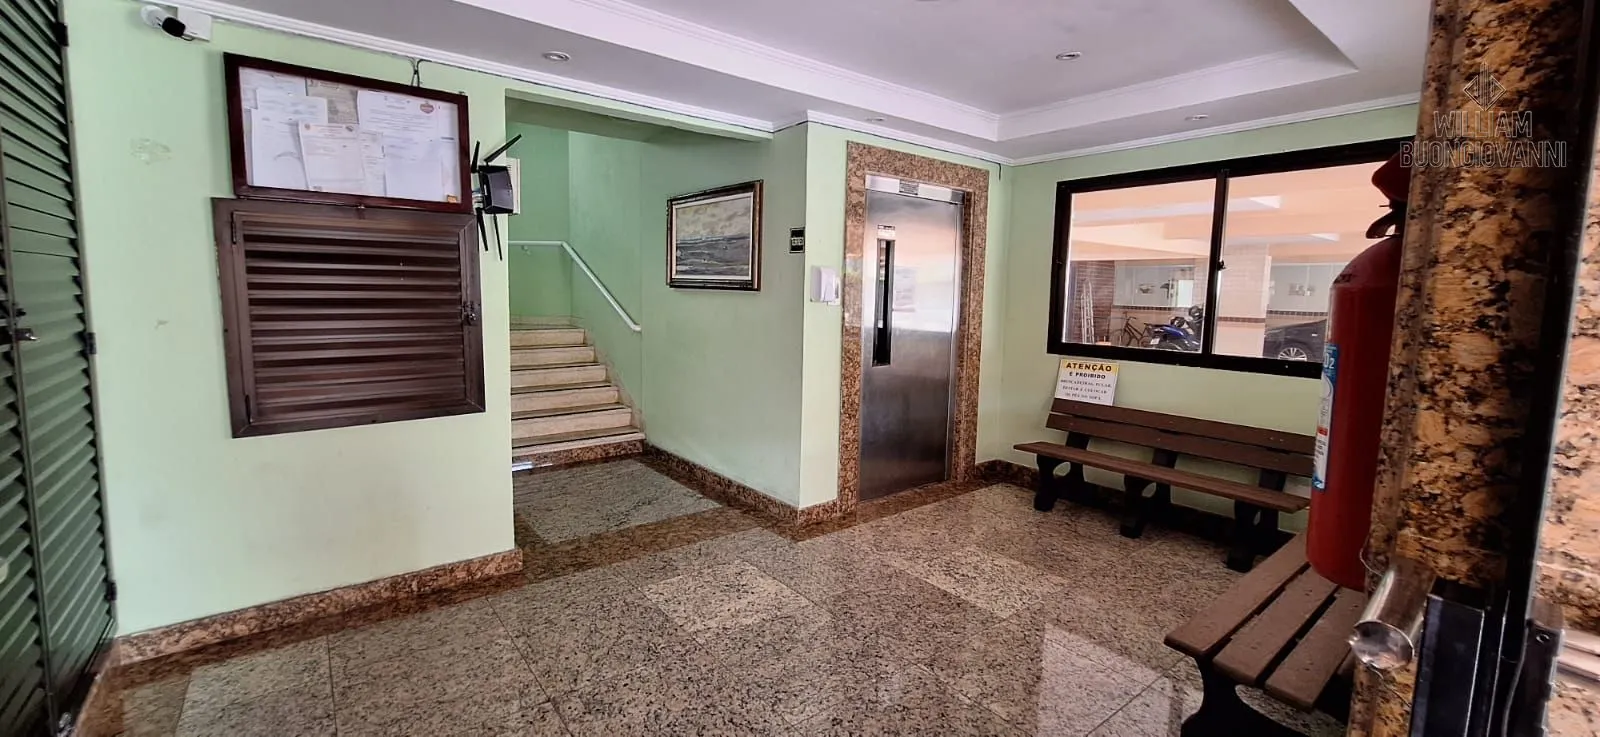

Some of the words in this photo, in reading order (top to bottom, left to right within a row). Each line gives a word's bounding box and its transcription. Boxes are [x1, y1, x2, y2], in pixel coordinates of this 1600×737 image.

[1323, 352, 1335, 369] O2
[1066, 362, 1112, 371] ATENÇÃO
[1075, 372, 1106, 380] PROIBIDO
